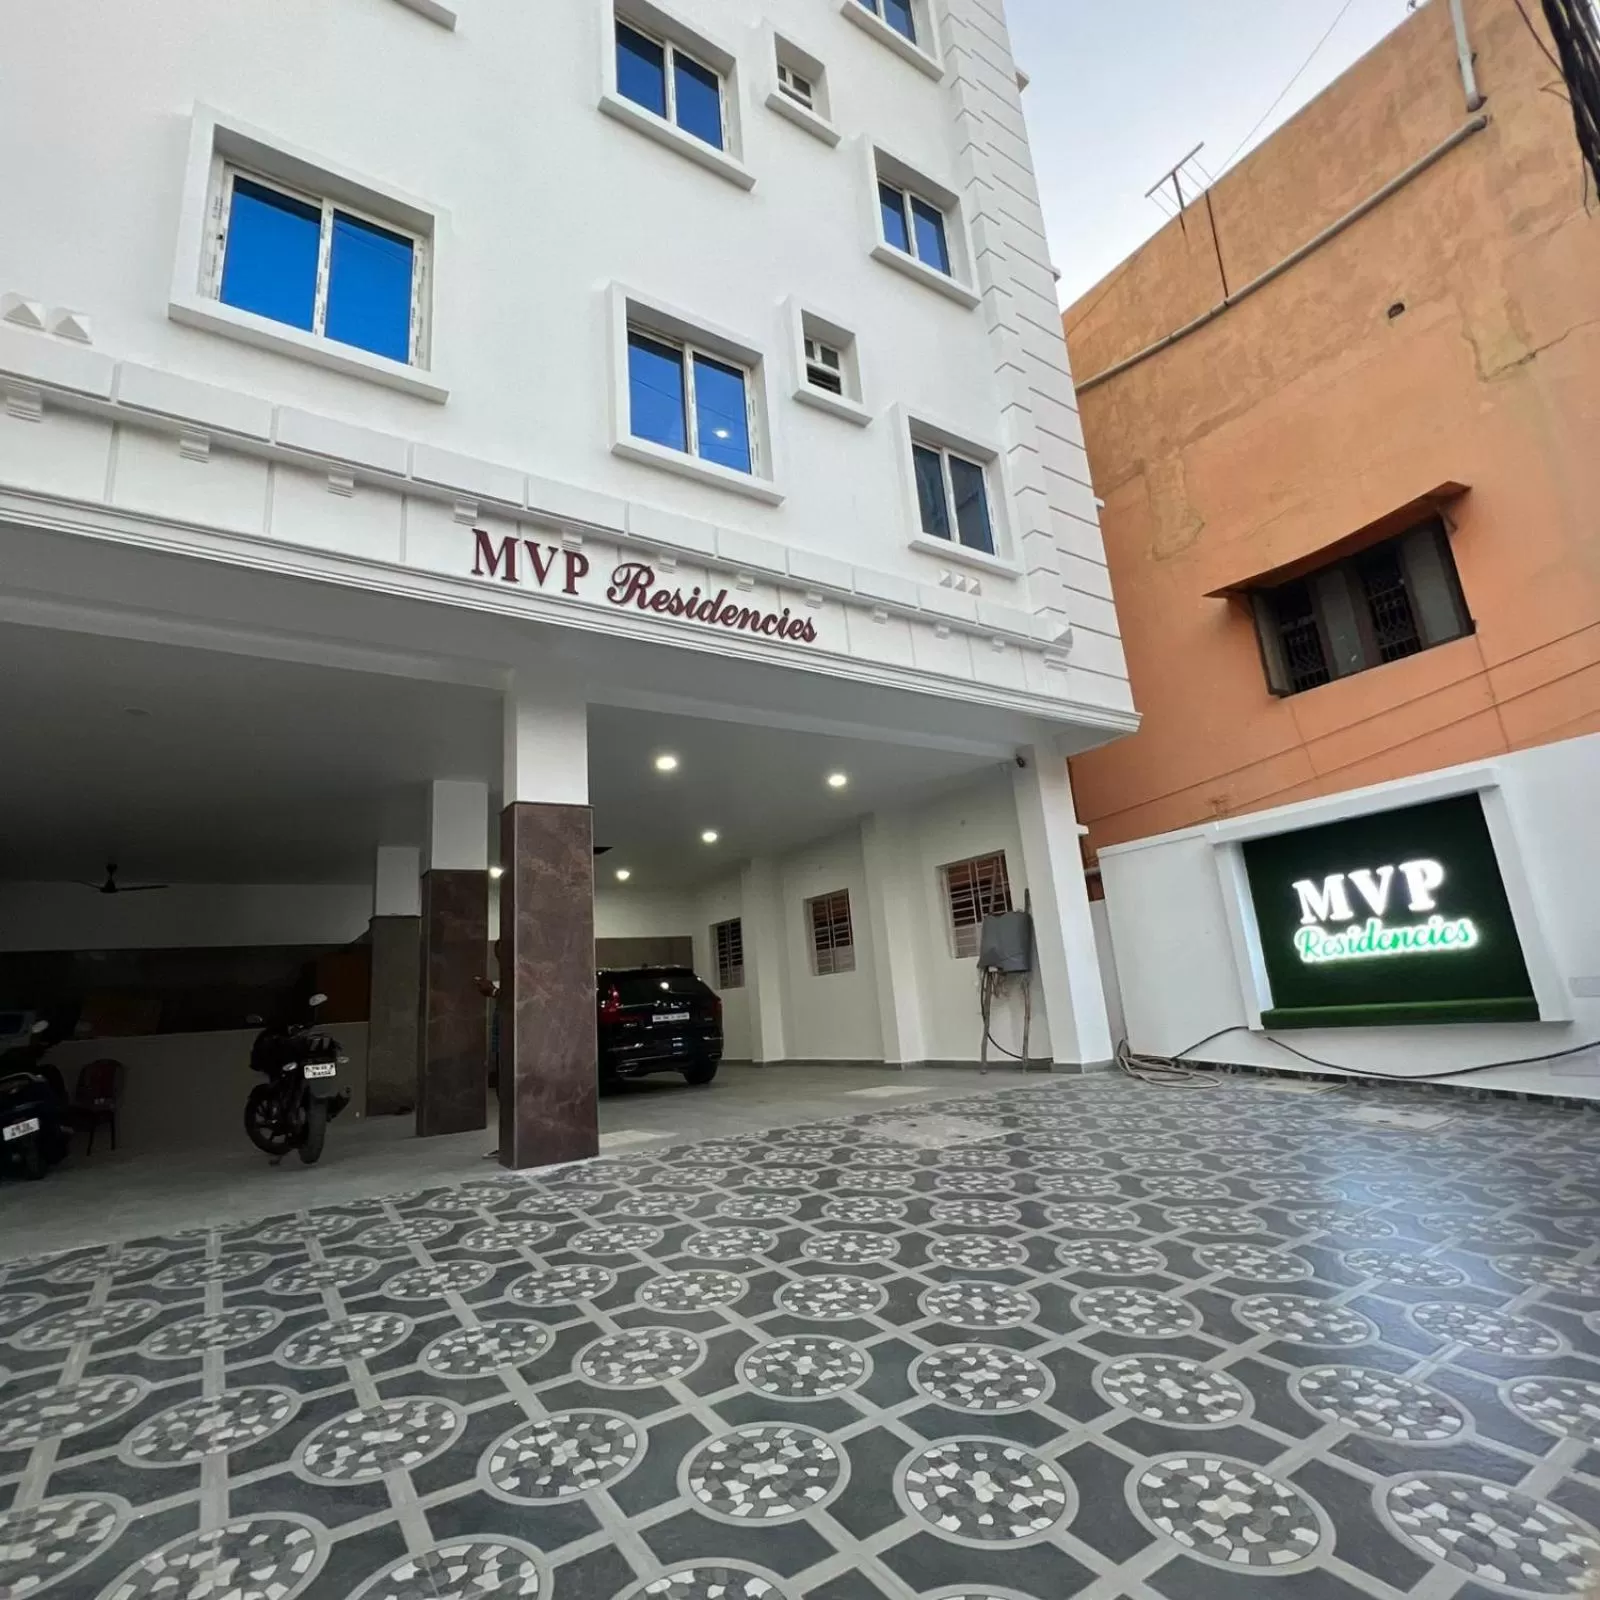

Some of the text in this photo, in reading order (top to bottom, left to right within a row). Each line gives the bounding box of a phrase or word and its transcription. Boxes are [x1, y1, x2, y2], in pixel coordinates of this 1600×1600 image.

[471, 528, 817, 643] MVP Residencies
[1292, 859, 1445, 925] MVP
[1295, 917, 1475, 961] Residencies
